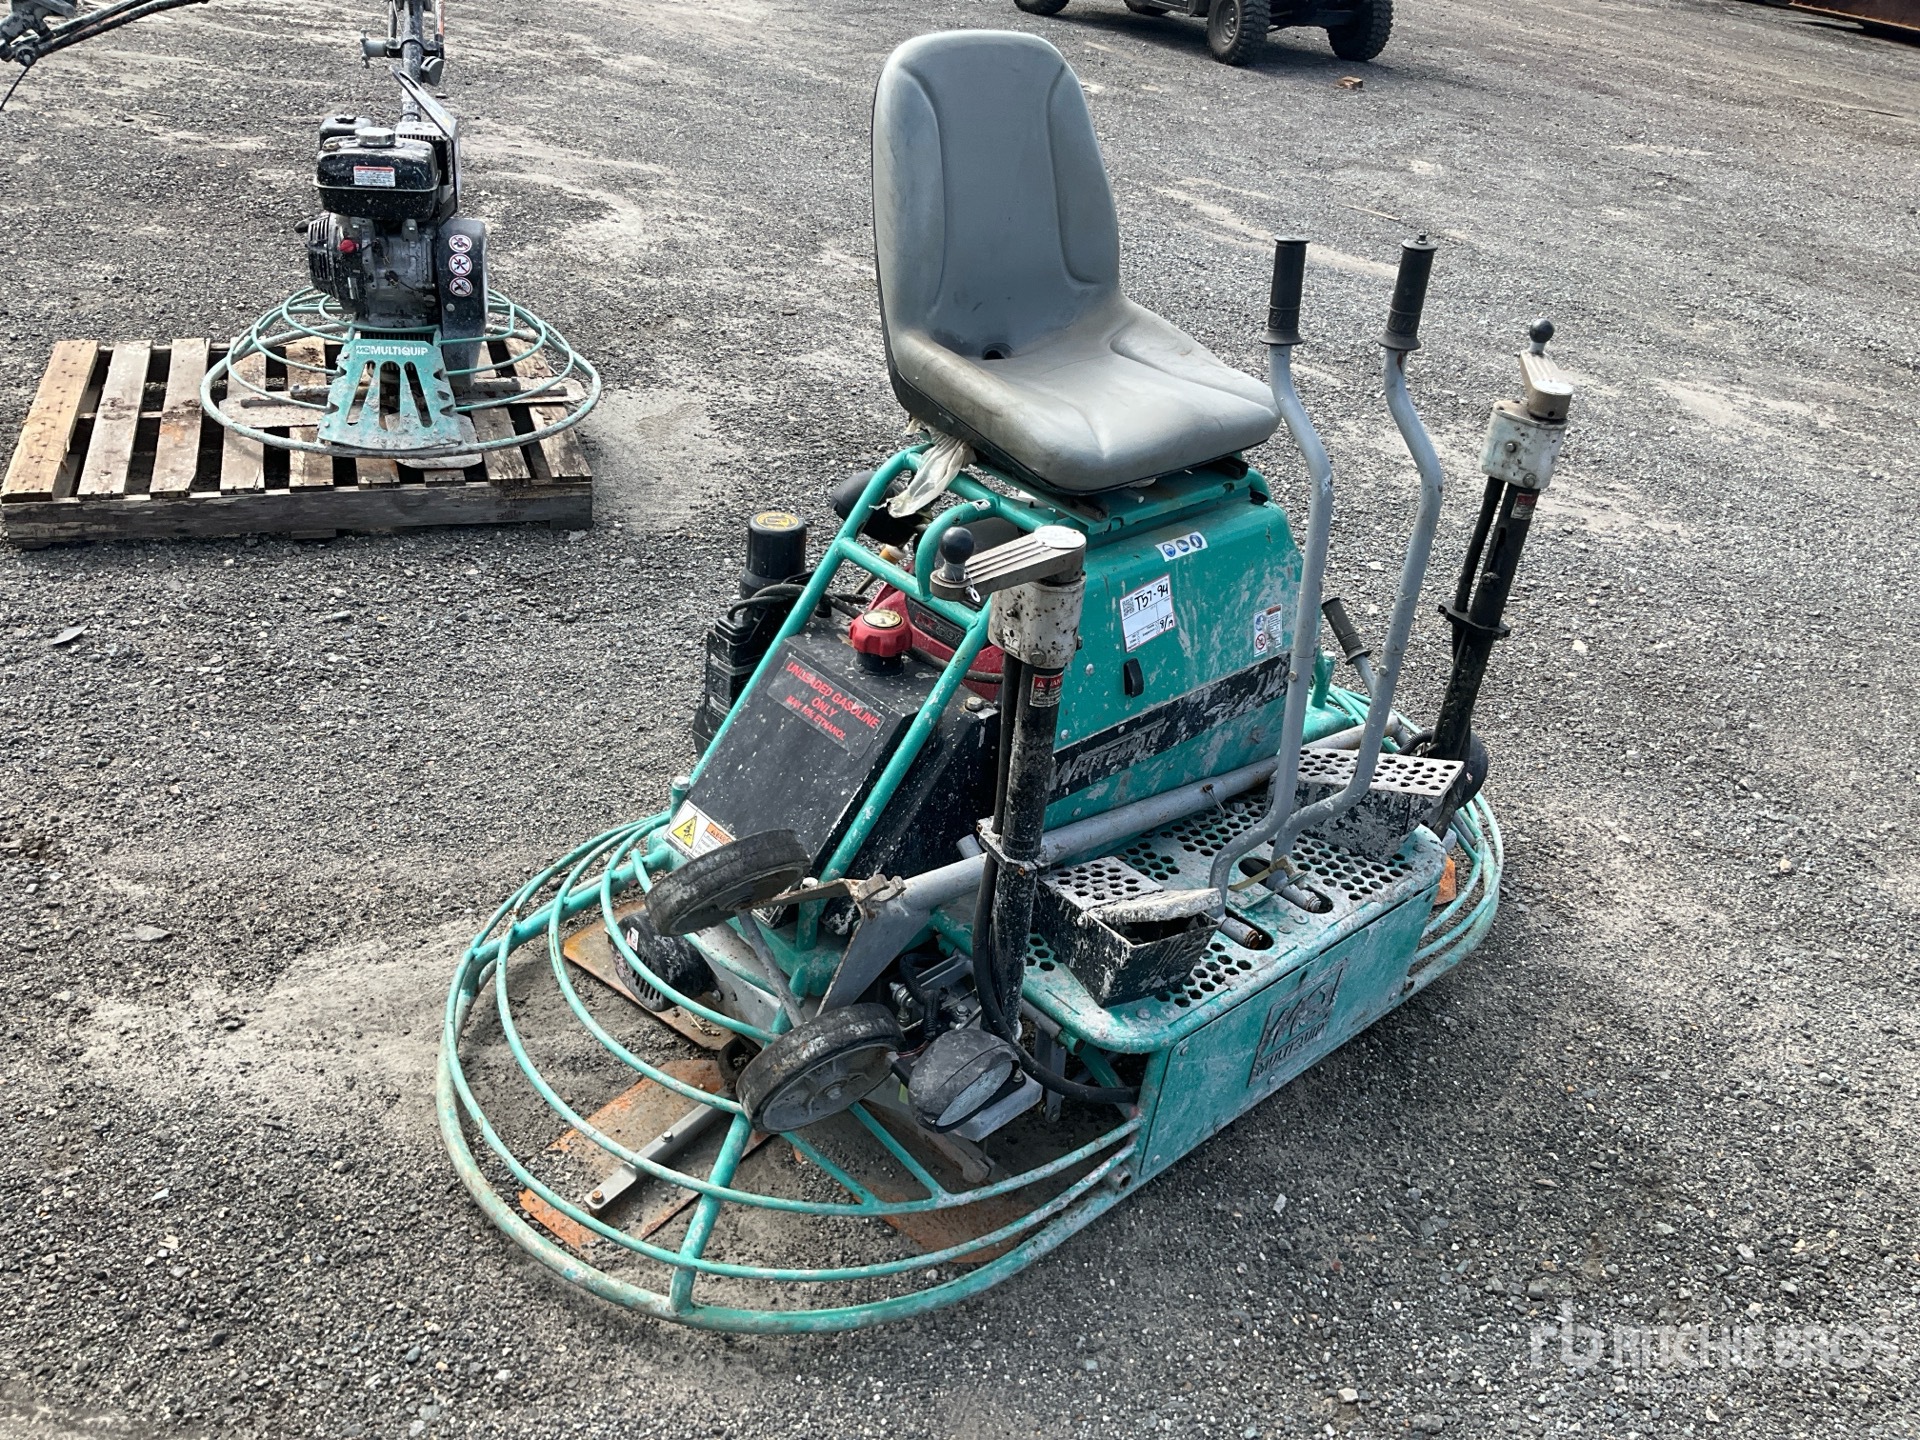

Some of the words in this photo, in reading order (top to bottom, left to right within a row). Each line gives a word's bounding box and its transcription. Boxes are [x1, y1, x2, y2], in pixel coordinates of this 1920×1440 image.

[371, 345, 428, 356] MULTIQUIP
[1134, 584, 1169, 611] T57-94
[786, 661, 833, 697] UNLEADED
[831, 692, 881, 729] GASOLINE
[811, 697, 839, 718] ONLY
[786, 694, 802, 709] MAX
[814, 715, 846, 741] ETHANOL
